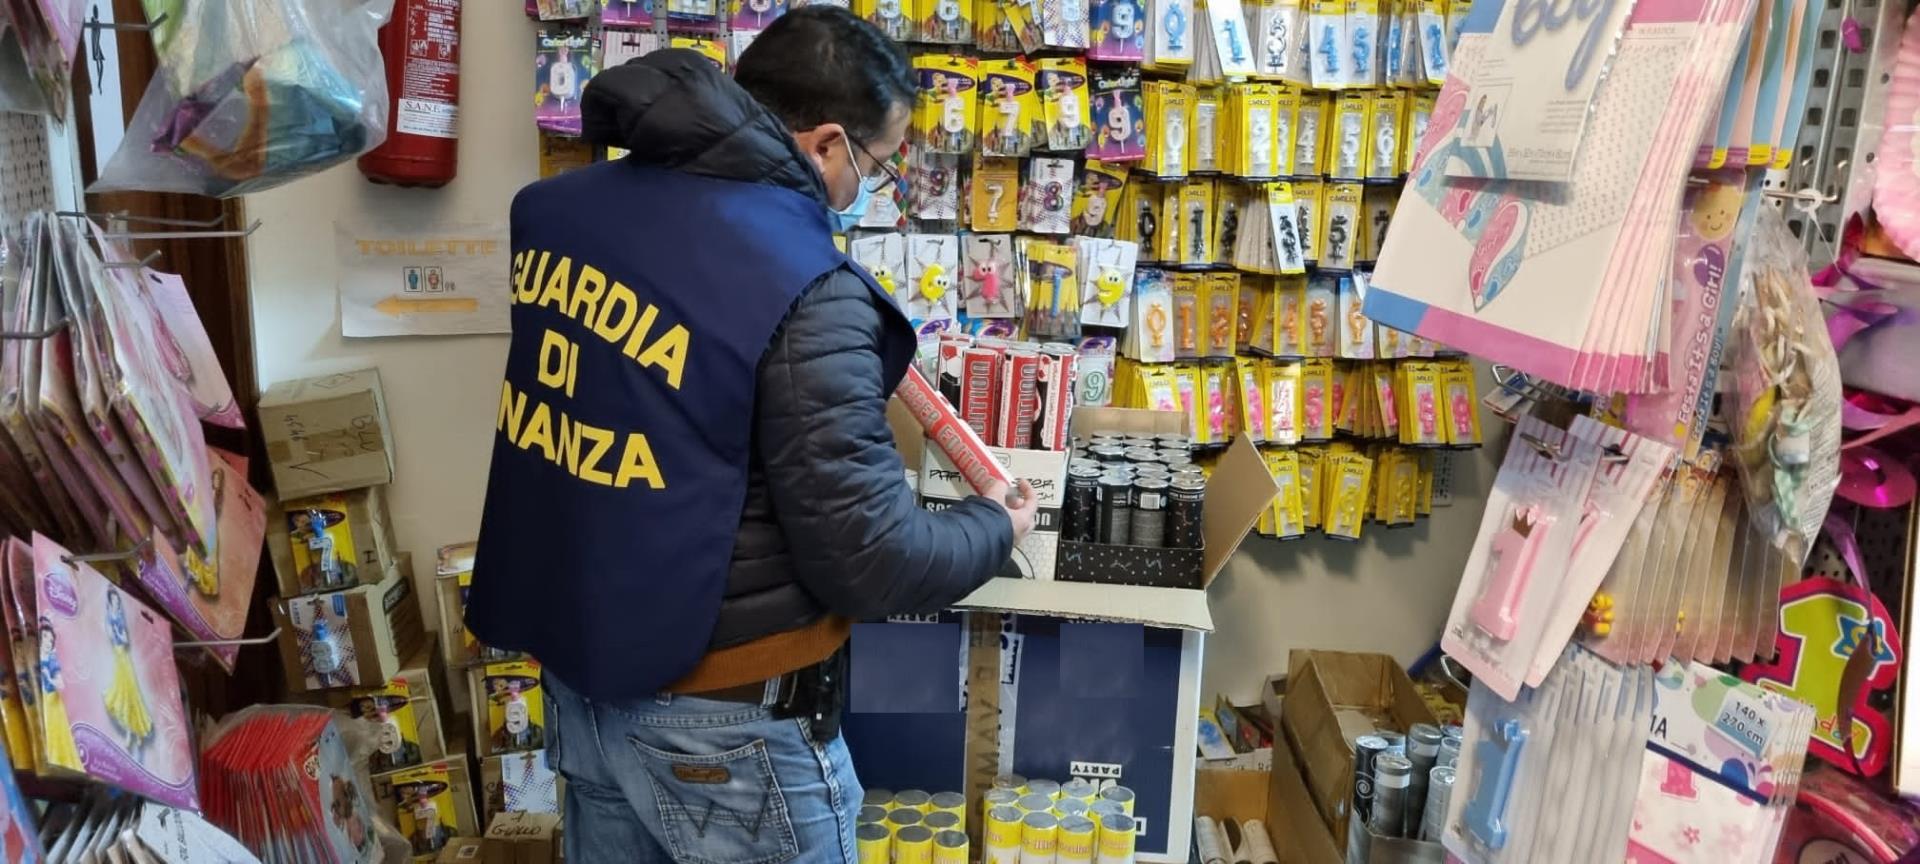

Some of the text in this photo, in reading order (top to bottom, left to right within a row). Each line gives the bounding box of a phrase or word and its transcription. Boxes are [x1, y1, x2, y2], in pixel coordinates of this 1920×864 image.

[356, 239, 497, 256] TOILETTE
[511, 249, 690, 390] GUARDIA
[538, 329, 579, 399] DI
[1083, 371, 1106, 402] 9
[1734, 702, 1757, 722] 140
[1722, 713, 1764, 746] 270 cm
[1073, 764, 1119, 776] PARTY
